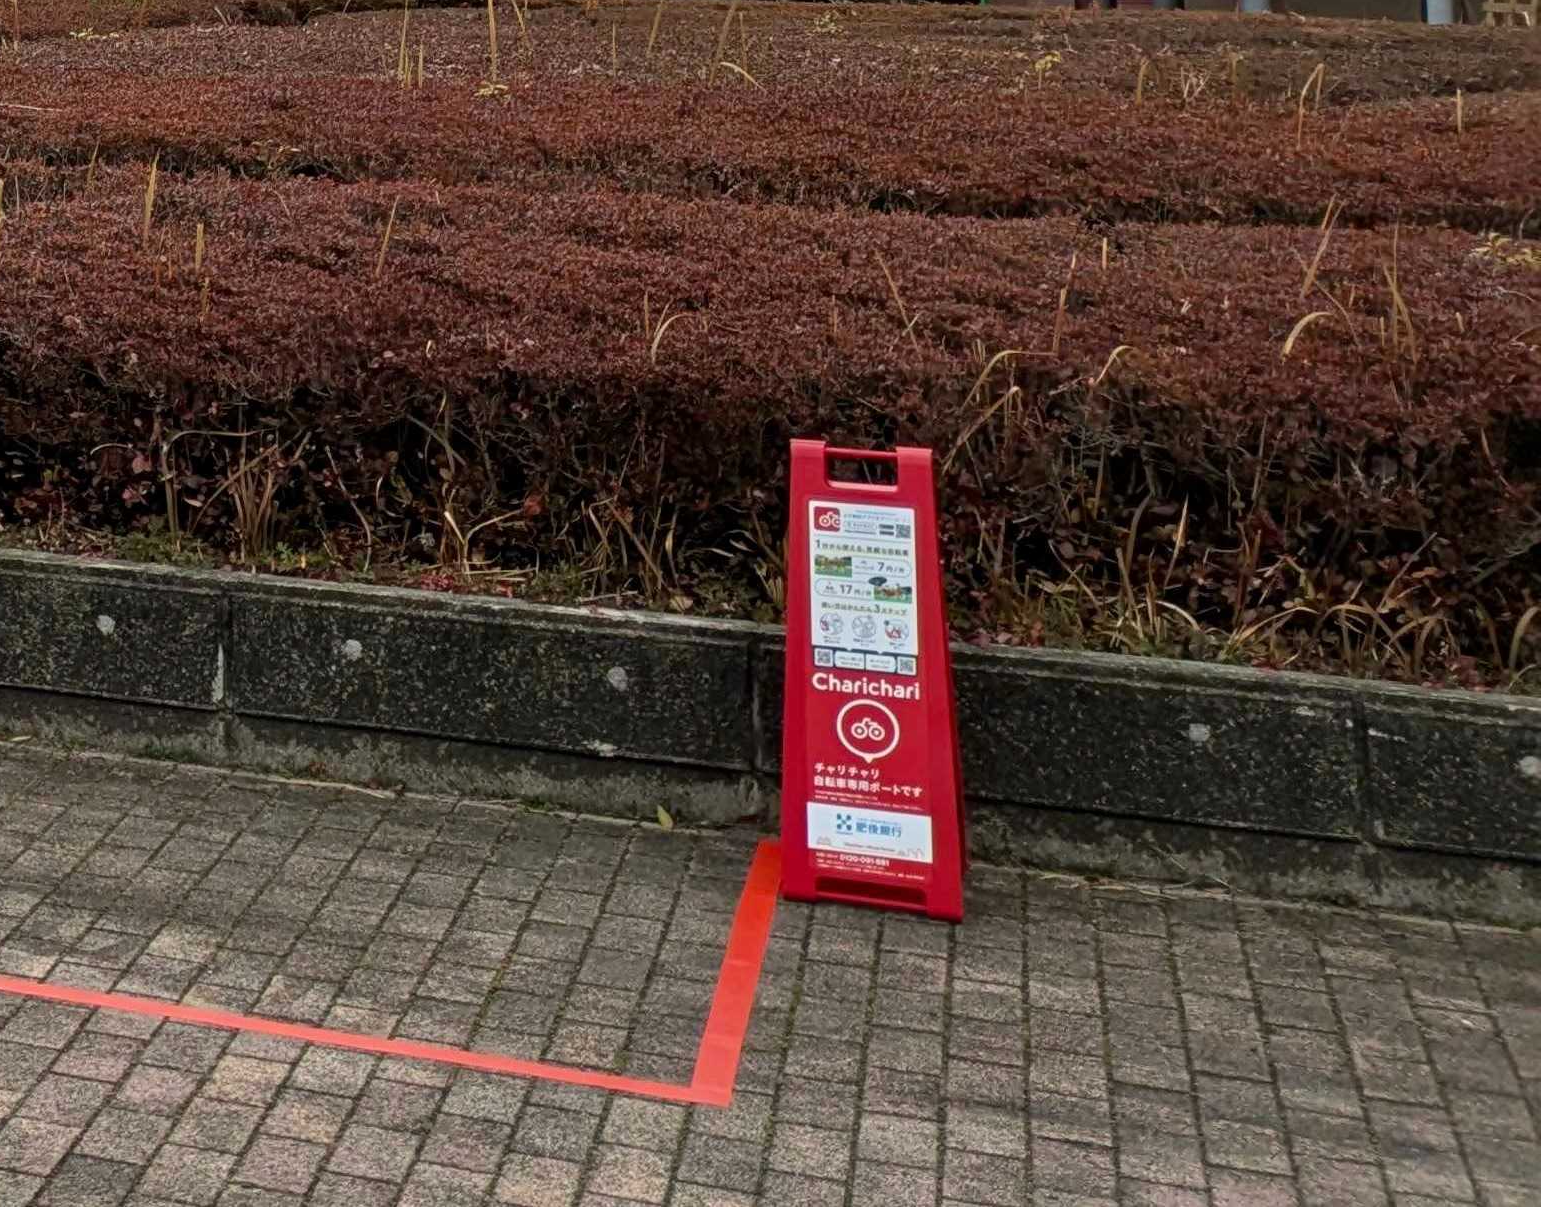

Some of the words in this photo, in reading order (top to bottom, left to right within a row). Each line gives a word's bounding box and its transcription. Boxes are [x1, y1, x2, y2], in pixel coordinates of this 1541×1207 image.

[812, 672, 920, 700] Charichari
[814, 762, 879, 780] チャリチャリ
[814, 775, 923, 798] 自転車専用ポートです
